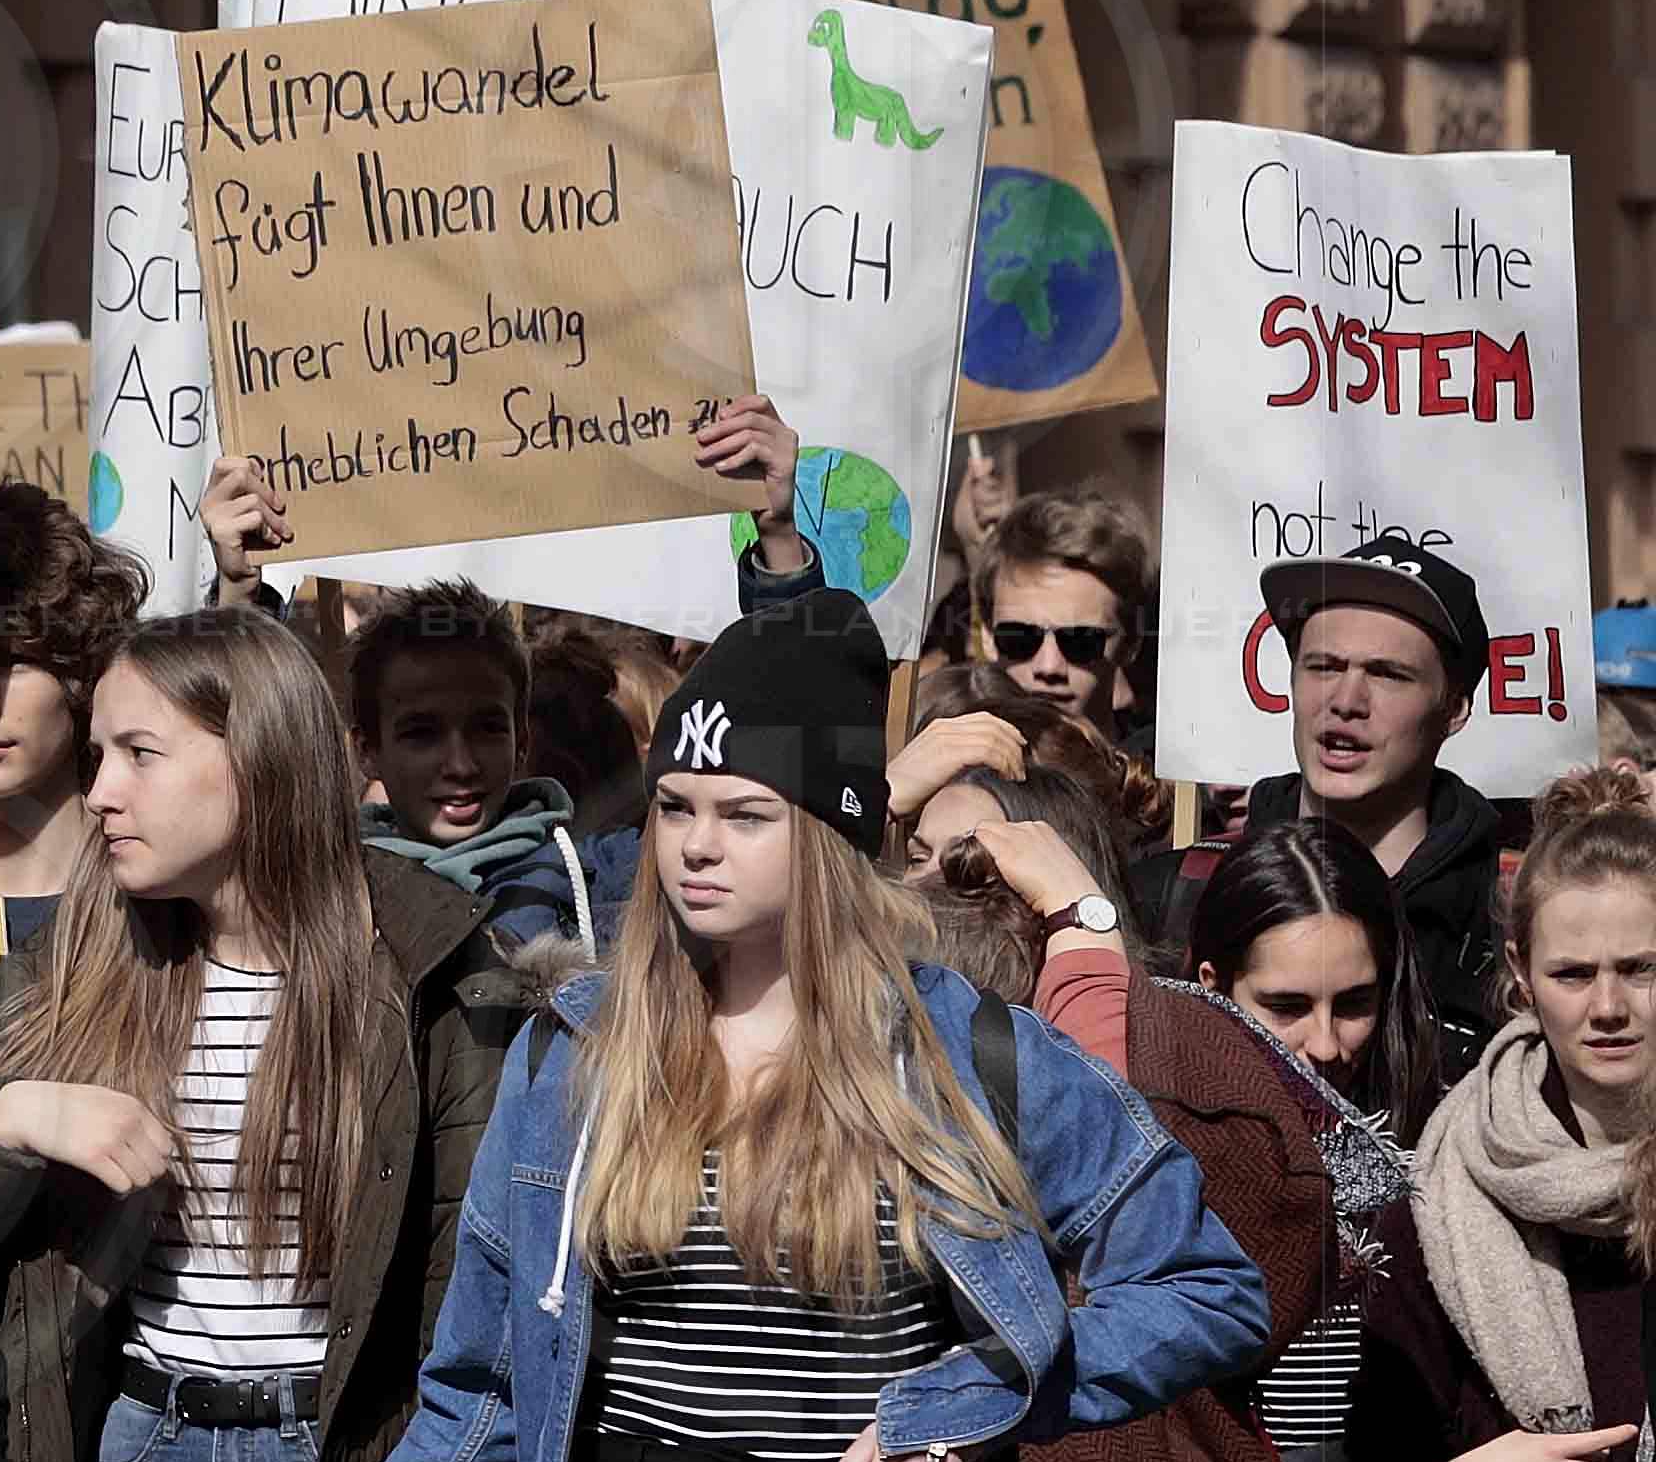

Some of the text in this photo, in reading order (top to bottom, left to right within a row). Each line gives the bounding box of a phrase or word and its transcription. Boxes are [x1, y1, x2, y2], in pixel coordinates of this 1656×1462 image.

[194, 20, 611, 153] Klimawandel
[210, 143, 621, 293] fügt Ihnen und
[1242, 161, 1534, 333] Change the
[232, 291, 587, 397] Ihrer Umgebung
[1259, 293, 1537, 424] SYSTEM
[502, 384, 672, 460] Schaden
[1251, 479, 1338, 559] not
